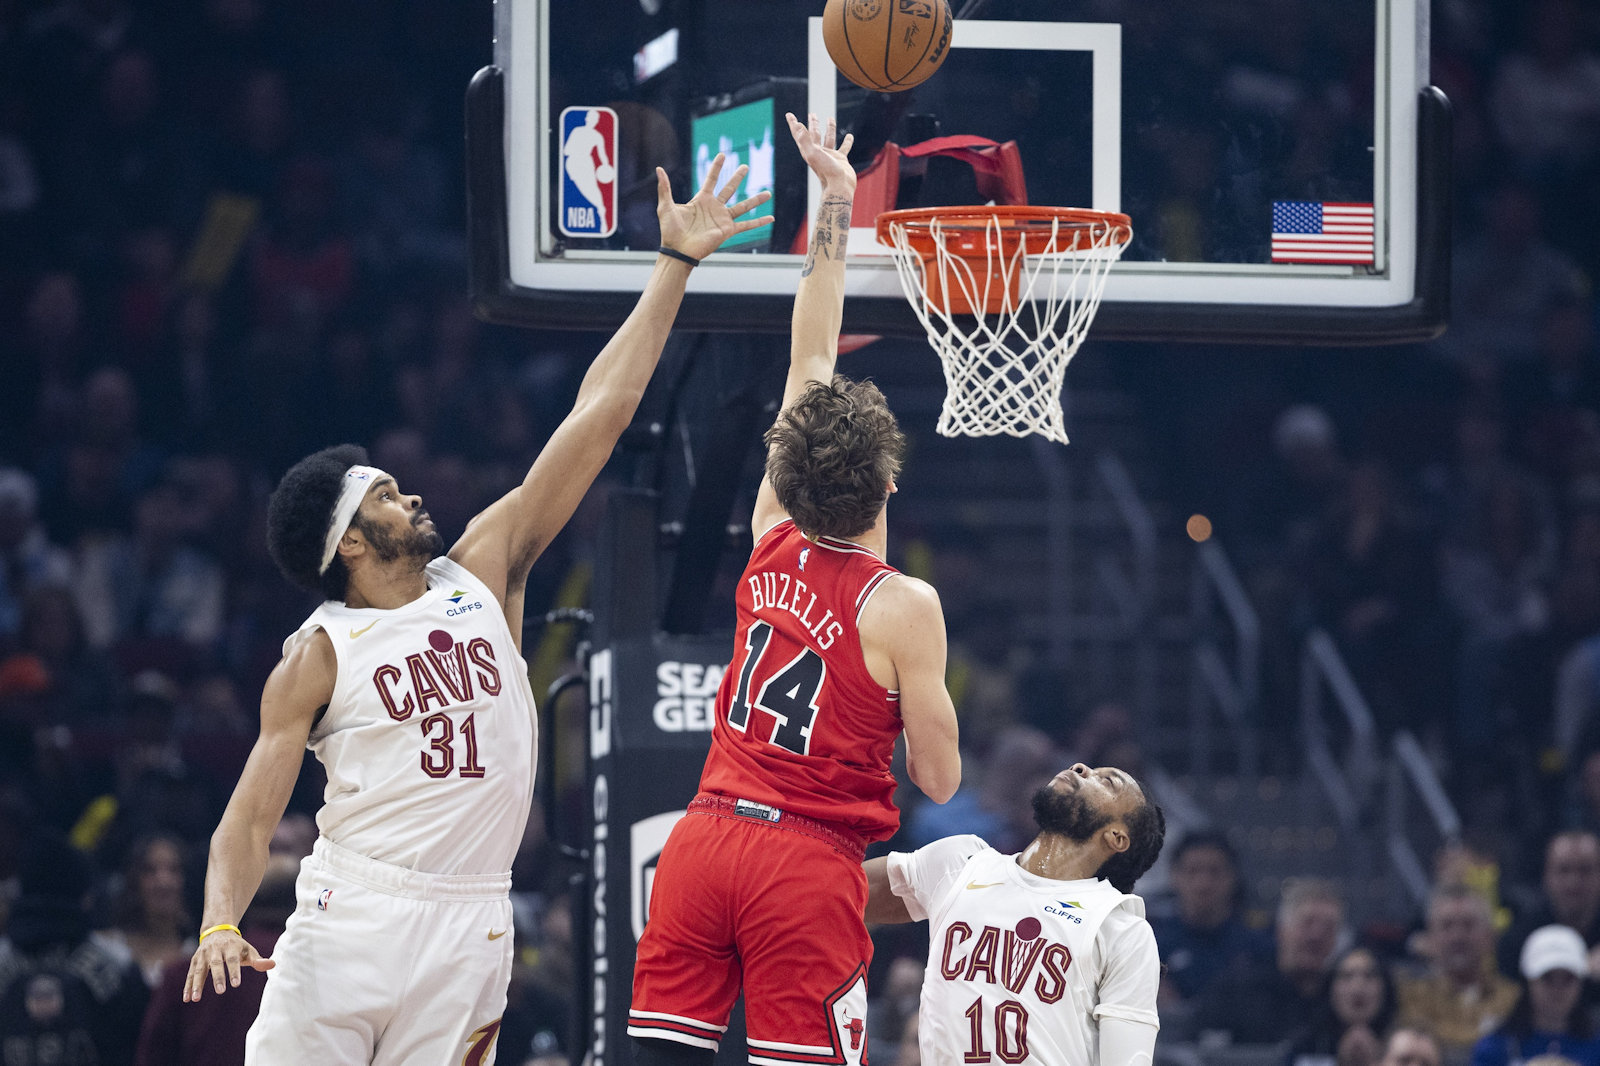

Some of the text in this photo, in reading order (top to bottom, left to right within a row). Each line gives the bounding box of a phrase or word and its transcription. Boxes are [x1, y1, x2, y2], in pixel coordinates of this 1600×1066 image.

[567, 207, 596, 229] NBA
[446, 601, 483, 617] CLIFFS
[748, 571, 843, 650] BUZELIS
[372, 636, 502, 722] CAVS
[656, 661, 729, 697] SEA
[727, 618, 827, 756] 14
[420, 711, 486, 779] 31
[652, 697, 716, 733] GE
[1044, 905, 1082, 925] CLIFFS
[940, 920, 1073, 1005] CAVS
[963, 994, 1030, 1065] 10
